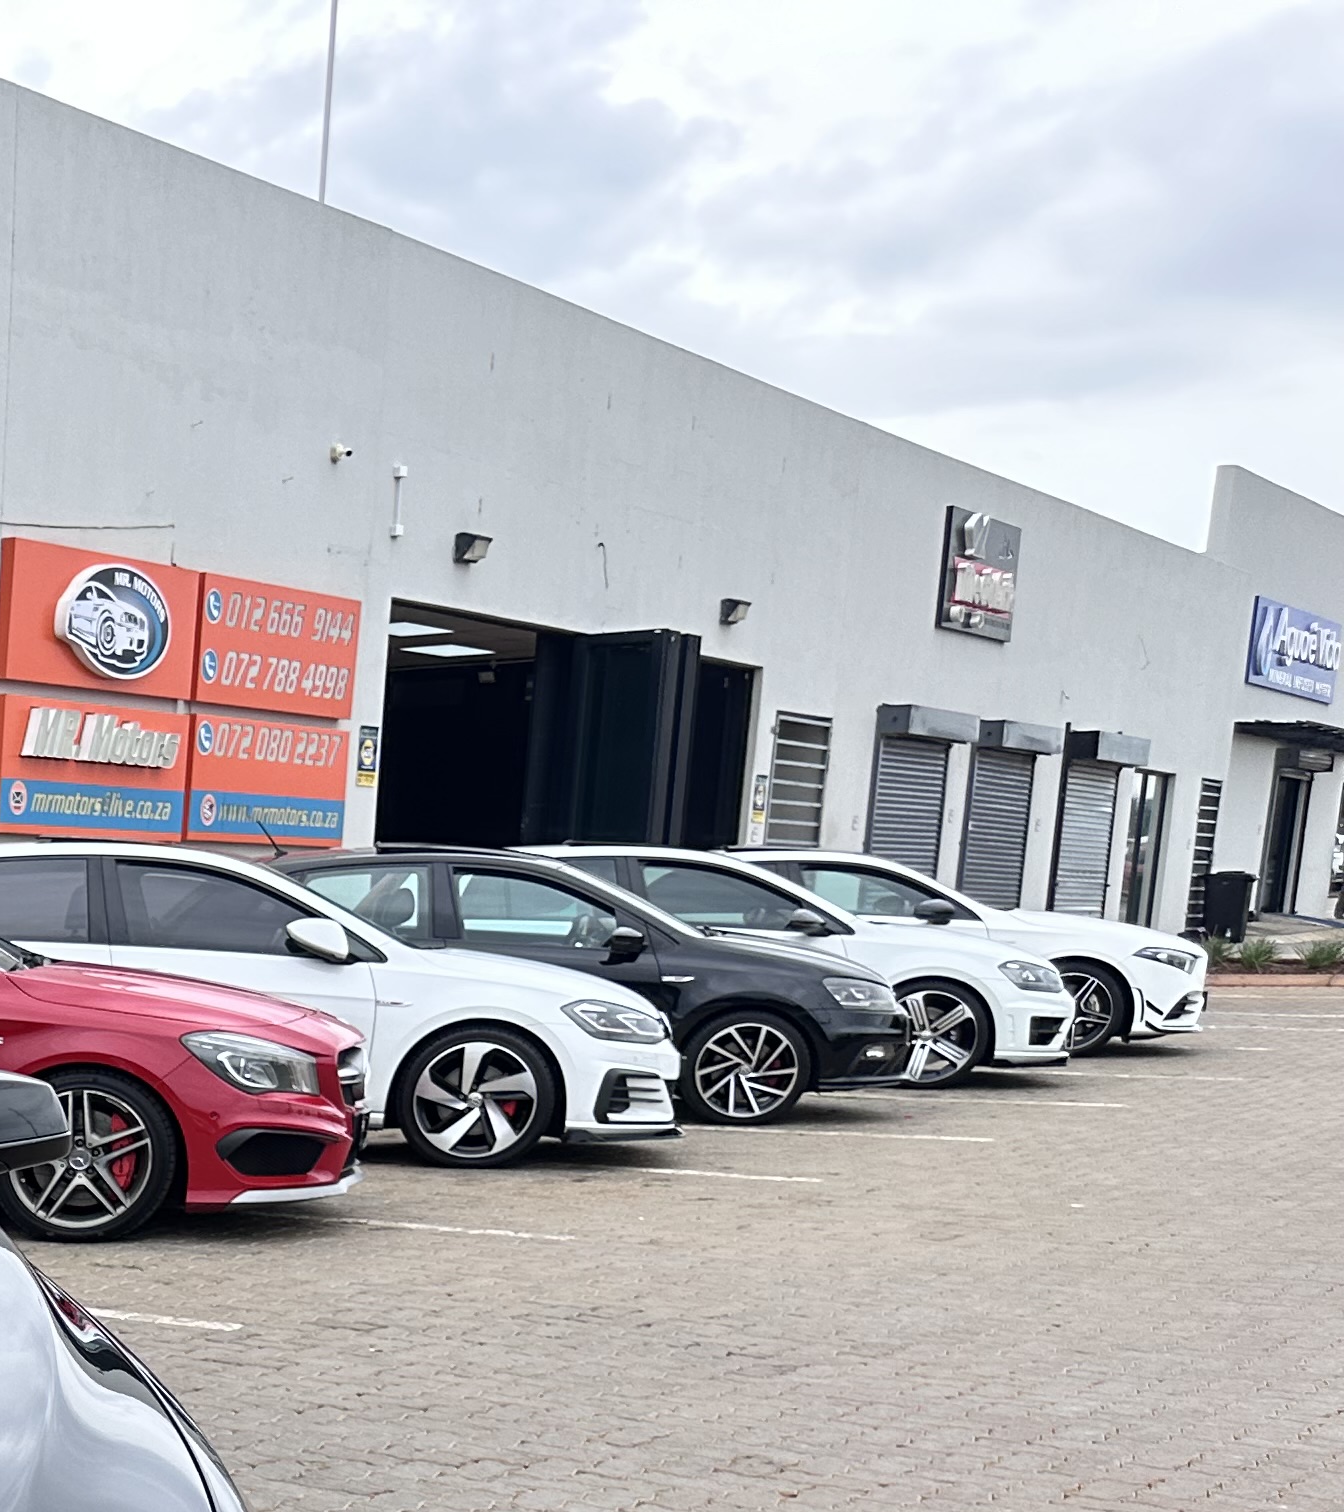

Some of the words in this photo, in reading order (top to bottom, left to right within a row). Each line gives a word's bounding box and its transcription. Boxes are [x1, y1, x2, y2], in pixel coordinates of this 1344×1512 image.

[132, 576, 166, 624] MOTORS
[225, 592, 267, 632] 012
[267, 599, 306, 638] 666
[311, 607, 354, 647] 9144
[221, 650, 262, 689] 072
[262, 656, 302, 694] 788
[300, 662, 350, 700] 4998
[20, 707, 83, 760] MR.
[79, 713, 181, 769] Motors
[214, 722, 254, 760] 072
[254, 726, 293, 763] 080
[293, 730, 343, 768] 2237
